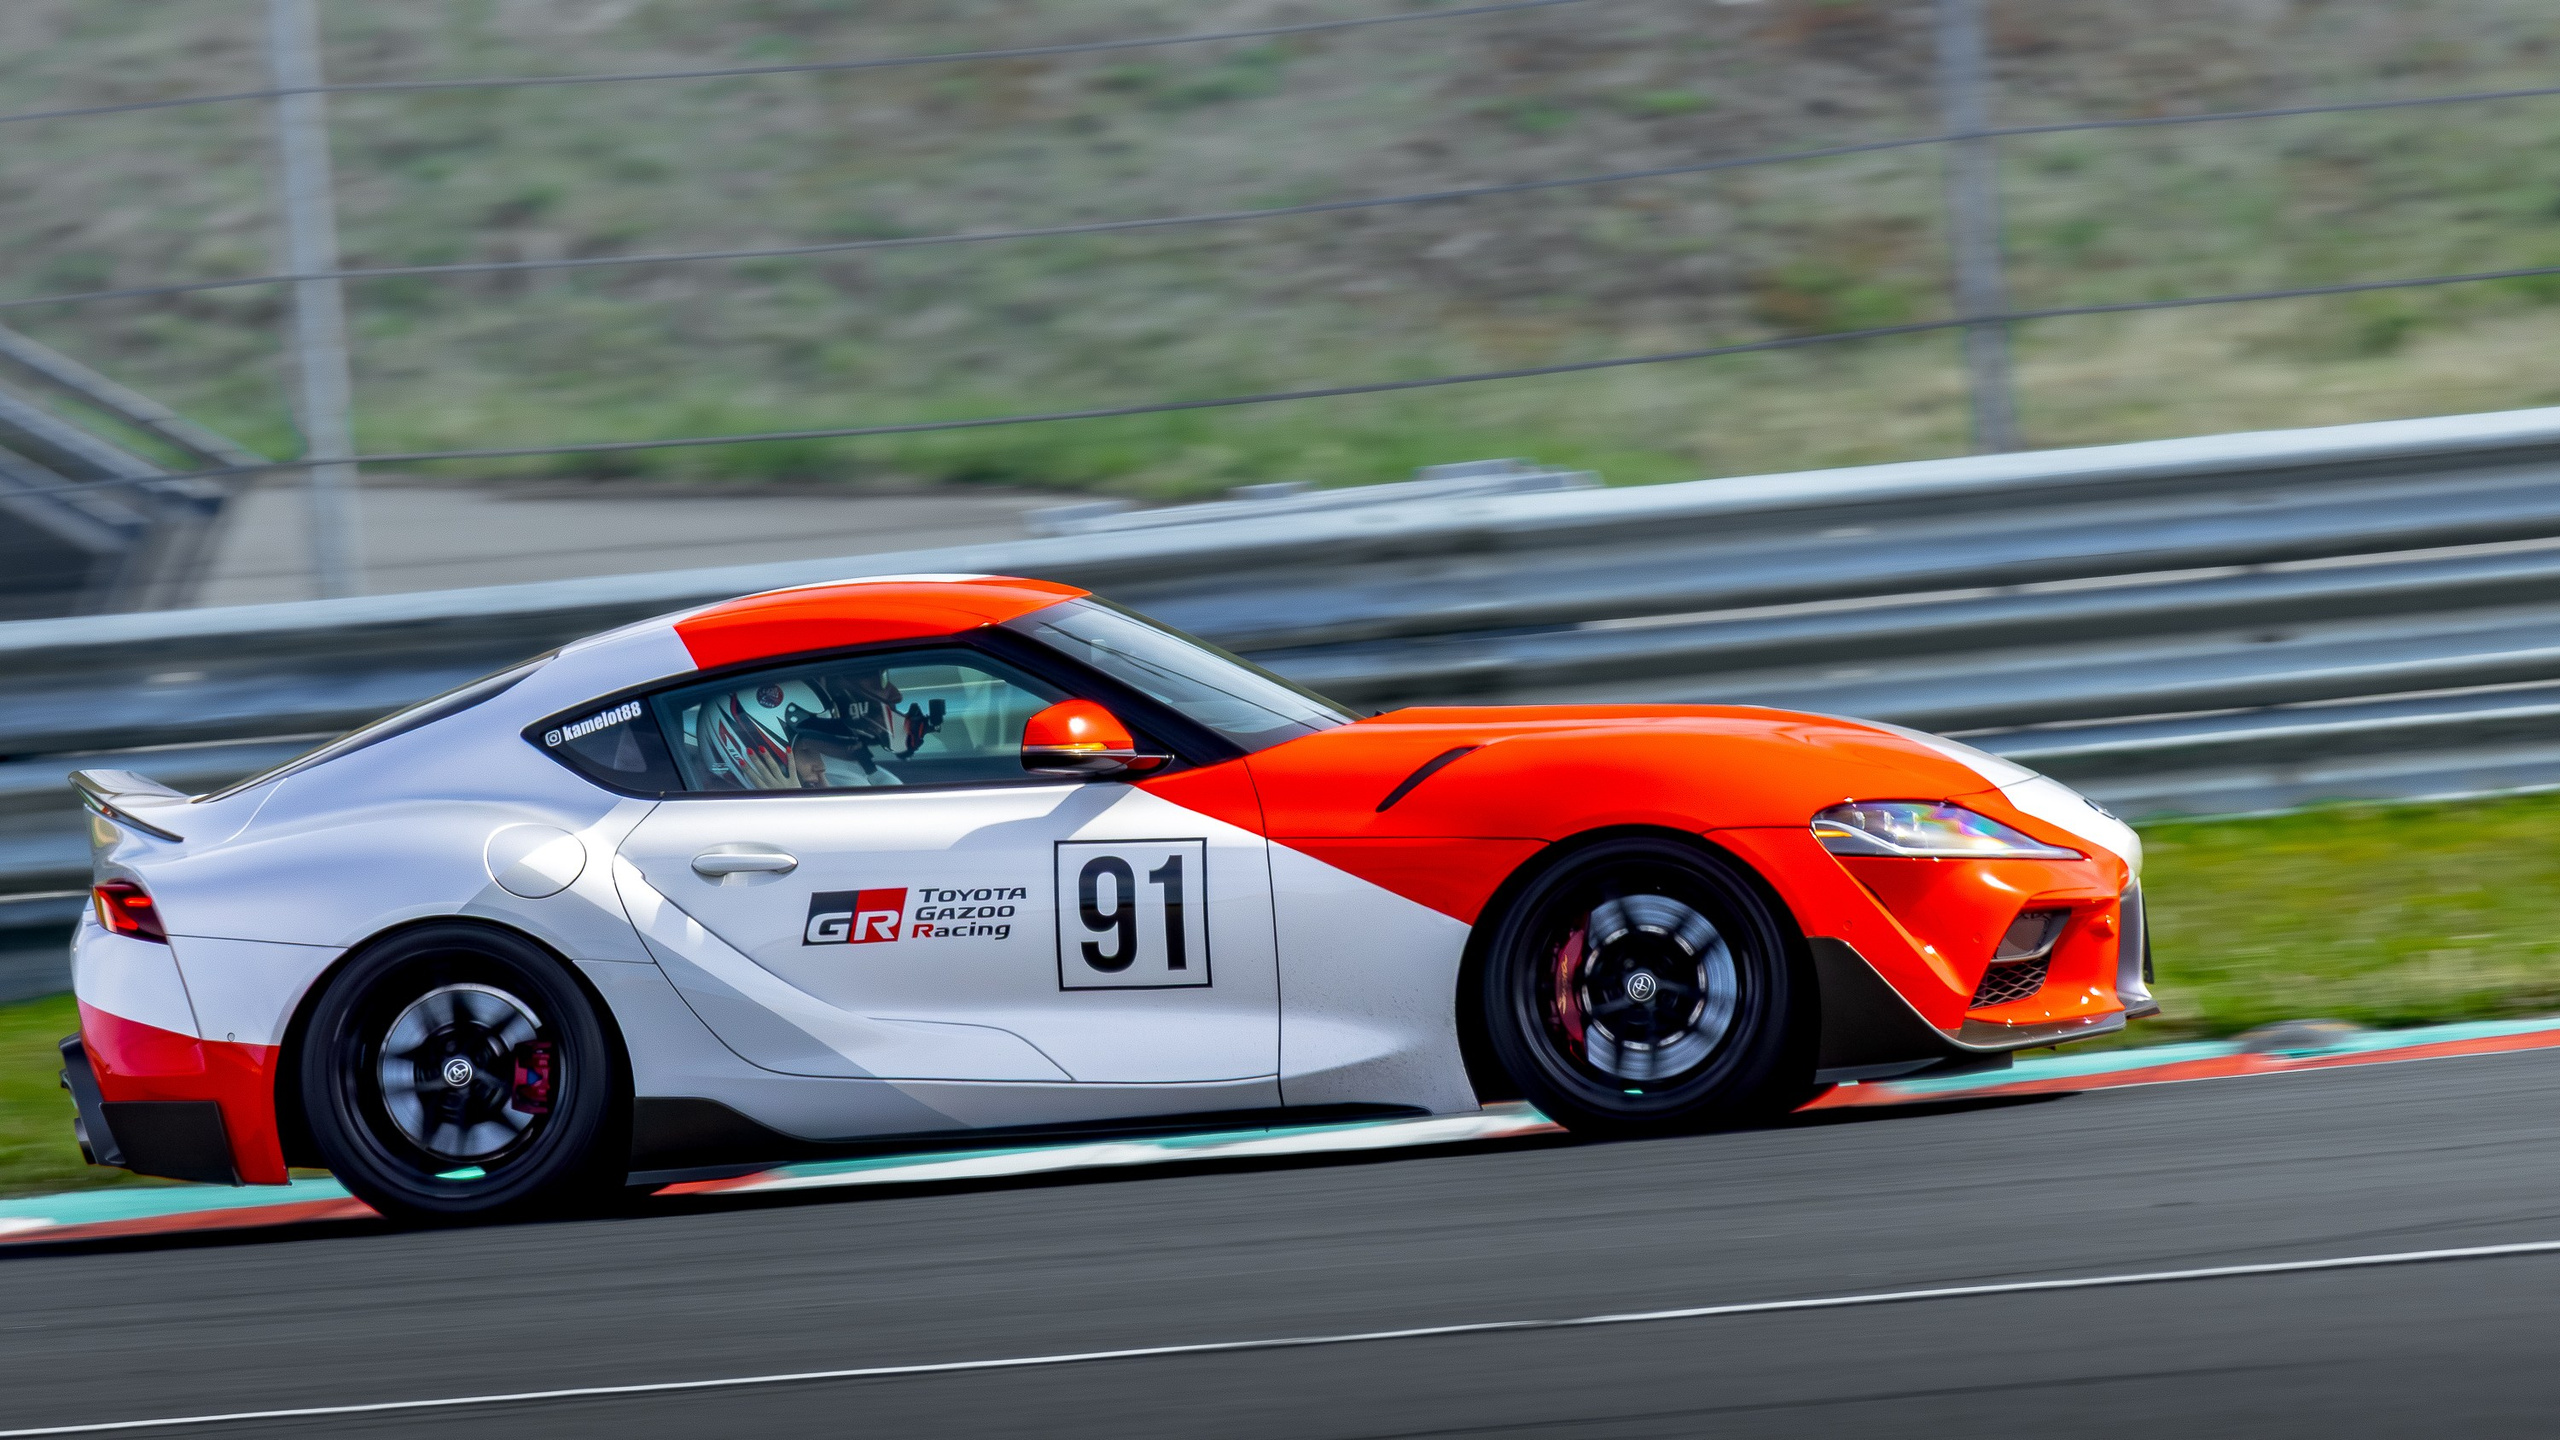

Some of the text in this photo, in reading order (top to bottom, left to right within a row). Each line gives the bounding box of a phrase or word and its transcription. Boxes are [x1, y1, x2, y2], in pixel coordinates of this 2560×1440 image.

[562, 700, 642, 741] kamelot88
[918, 887, 1027, 903] TOYOTA
[806, 909, 900, 943] GR
[915, 905, 1016, 921] GAZOO
[1078, 854, 1187, 973] 91
[911, 921, 1011, 940] Racing
